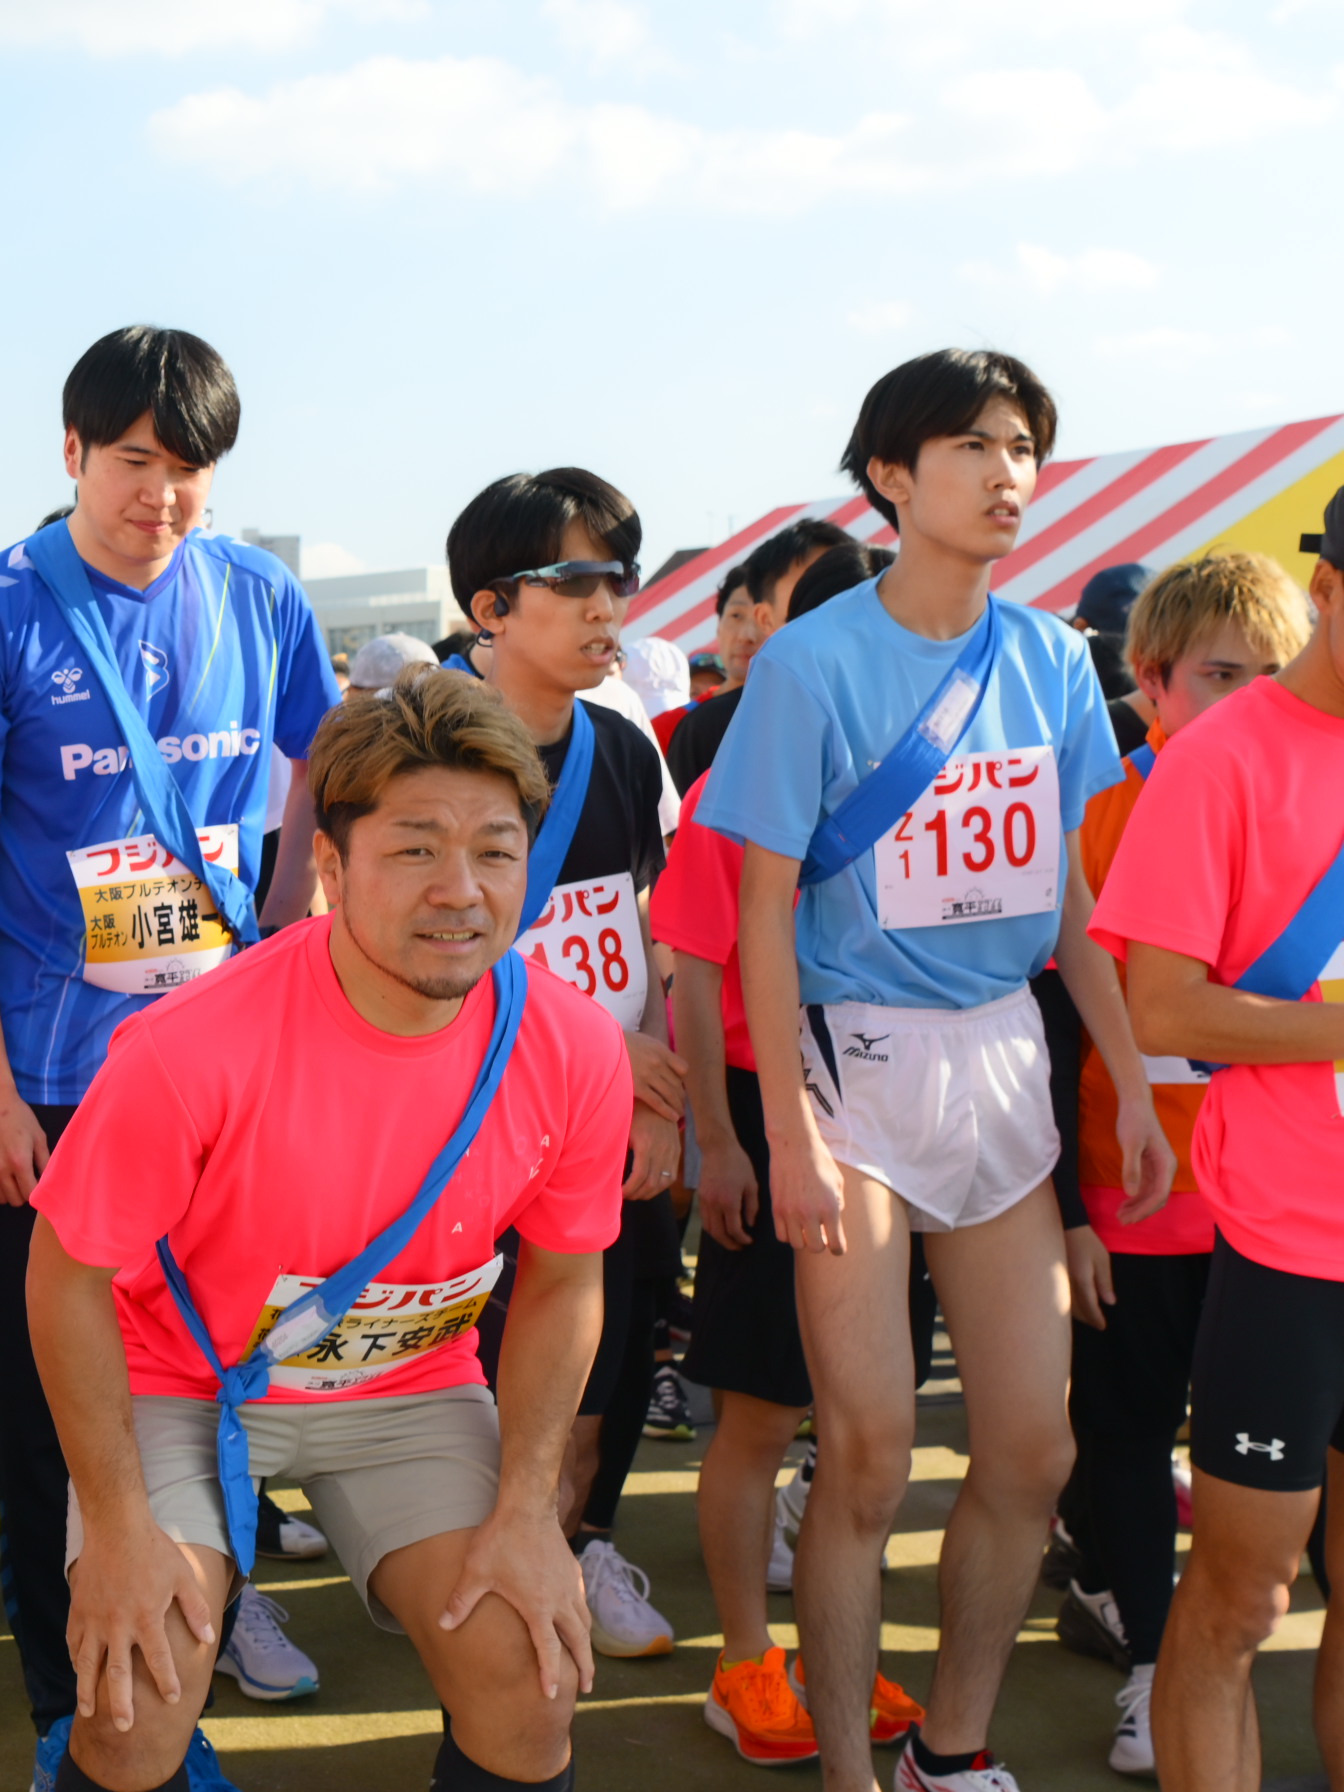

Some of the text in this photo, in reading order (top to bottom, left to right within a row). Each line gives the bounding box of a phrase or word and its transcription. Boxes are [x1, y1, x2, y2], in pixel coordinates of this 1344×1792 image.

[51, 689, 91, 705] hummel
[60, 720, 261, 781] Pansonic
[925, 802, 1036, 876] 130
[899, 849, 910, 879] 1
[90, 913, 116, 932] 大阪
[131, 898, 229, 950] 小宮雄一
